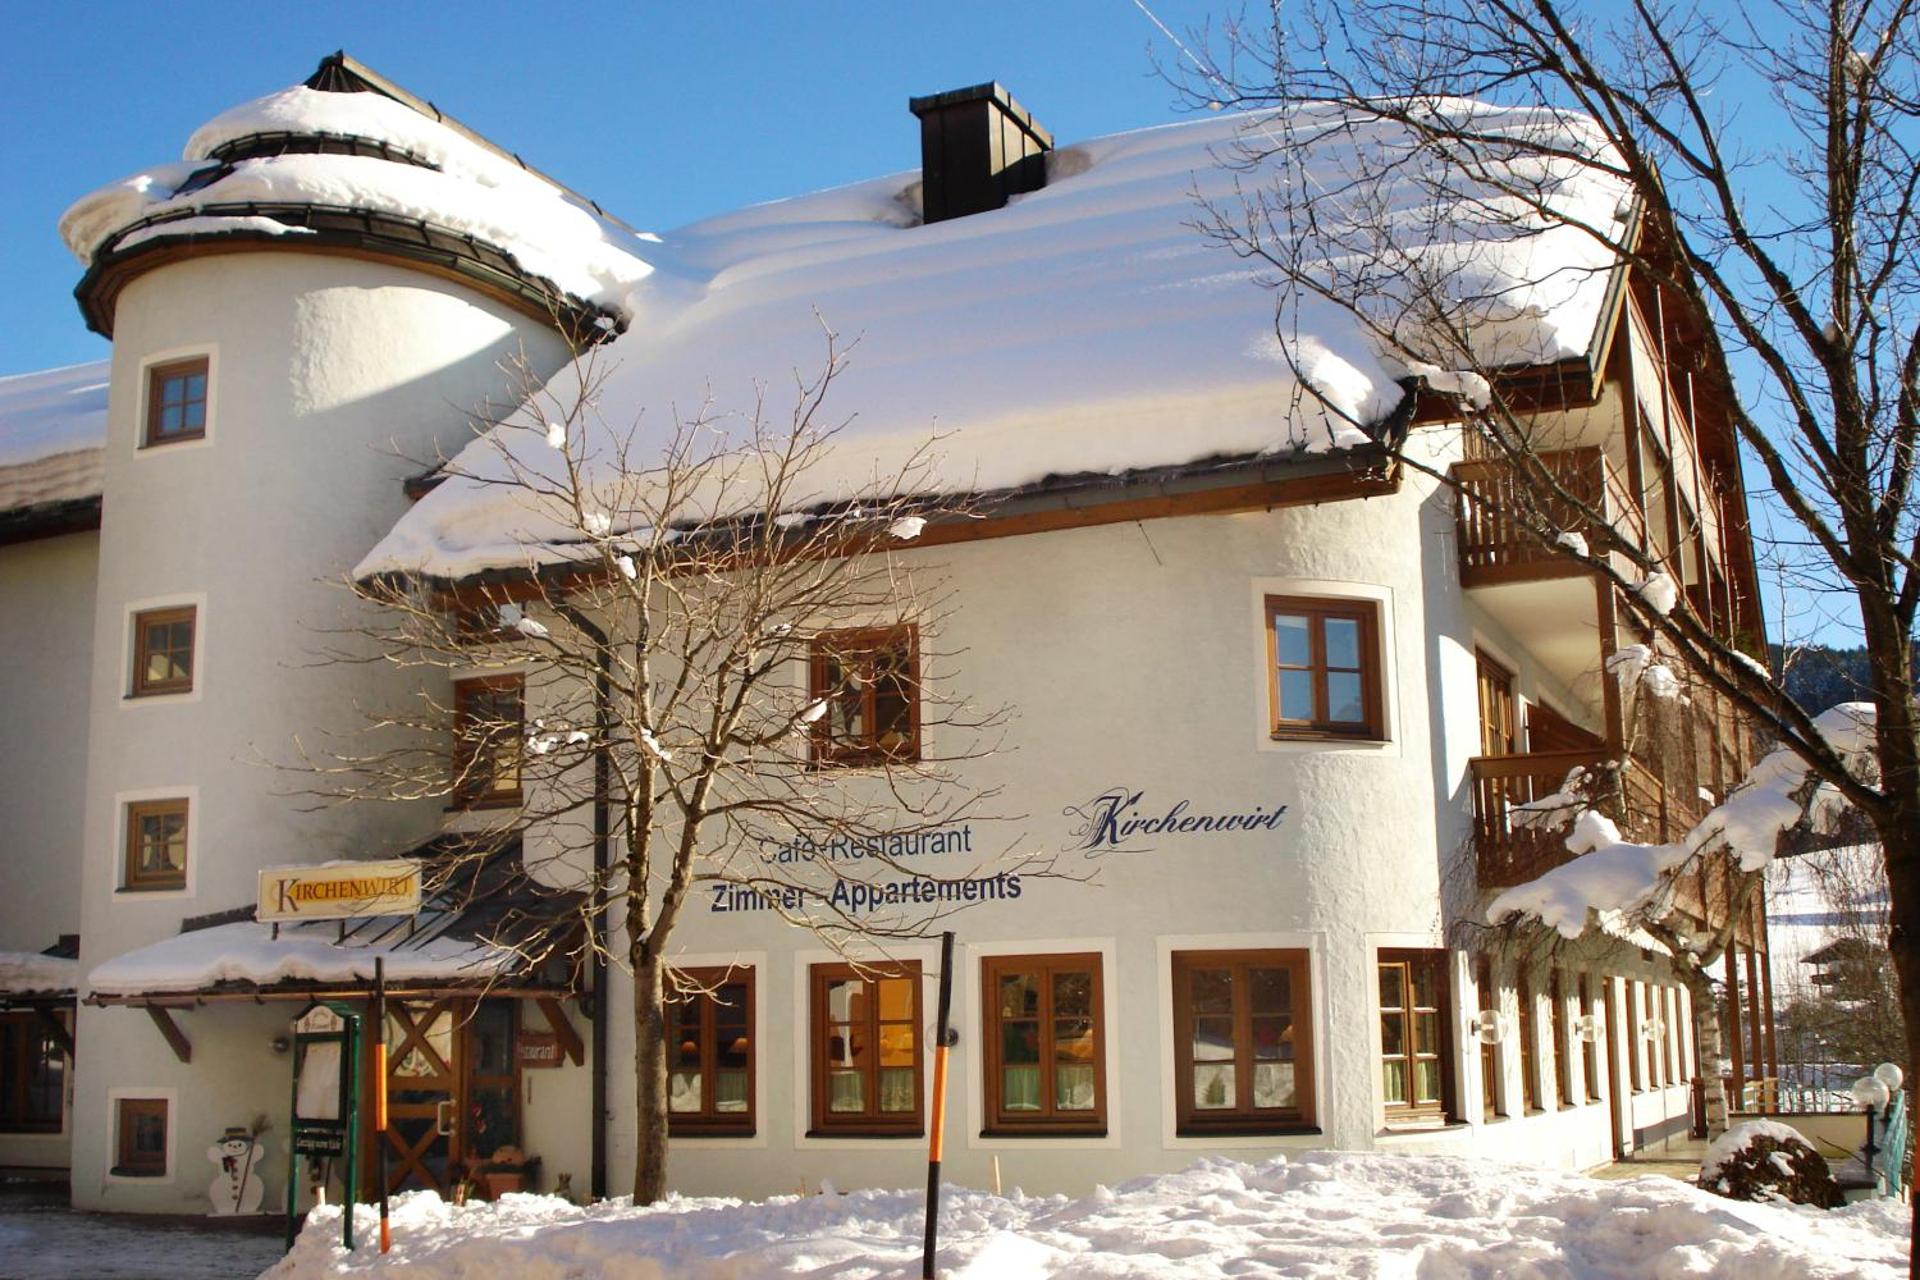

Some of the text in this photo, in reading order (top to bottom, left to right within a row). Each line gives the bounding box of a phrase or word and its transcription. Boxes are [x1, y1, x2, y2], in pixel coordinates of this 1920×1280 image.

[1063, 787, 1287, 859] Kirchenwirt
[276, 876, 413, 913] KIRCHENWIRT
[711, 883, 805, 912] Zimmer
[831, 870, 1021, 912] Appartements
